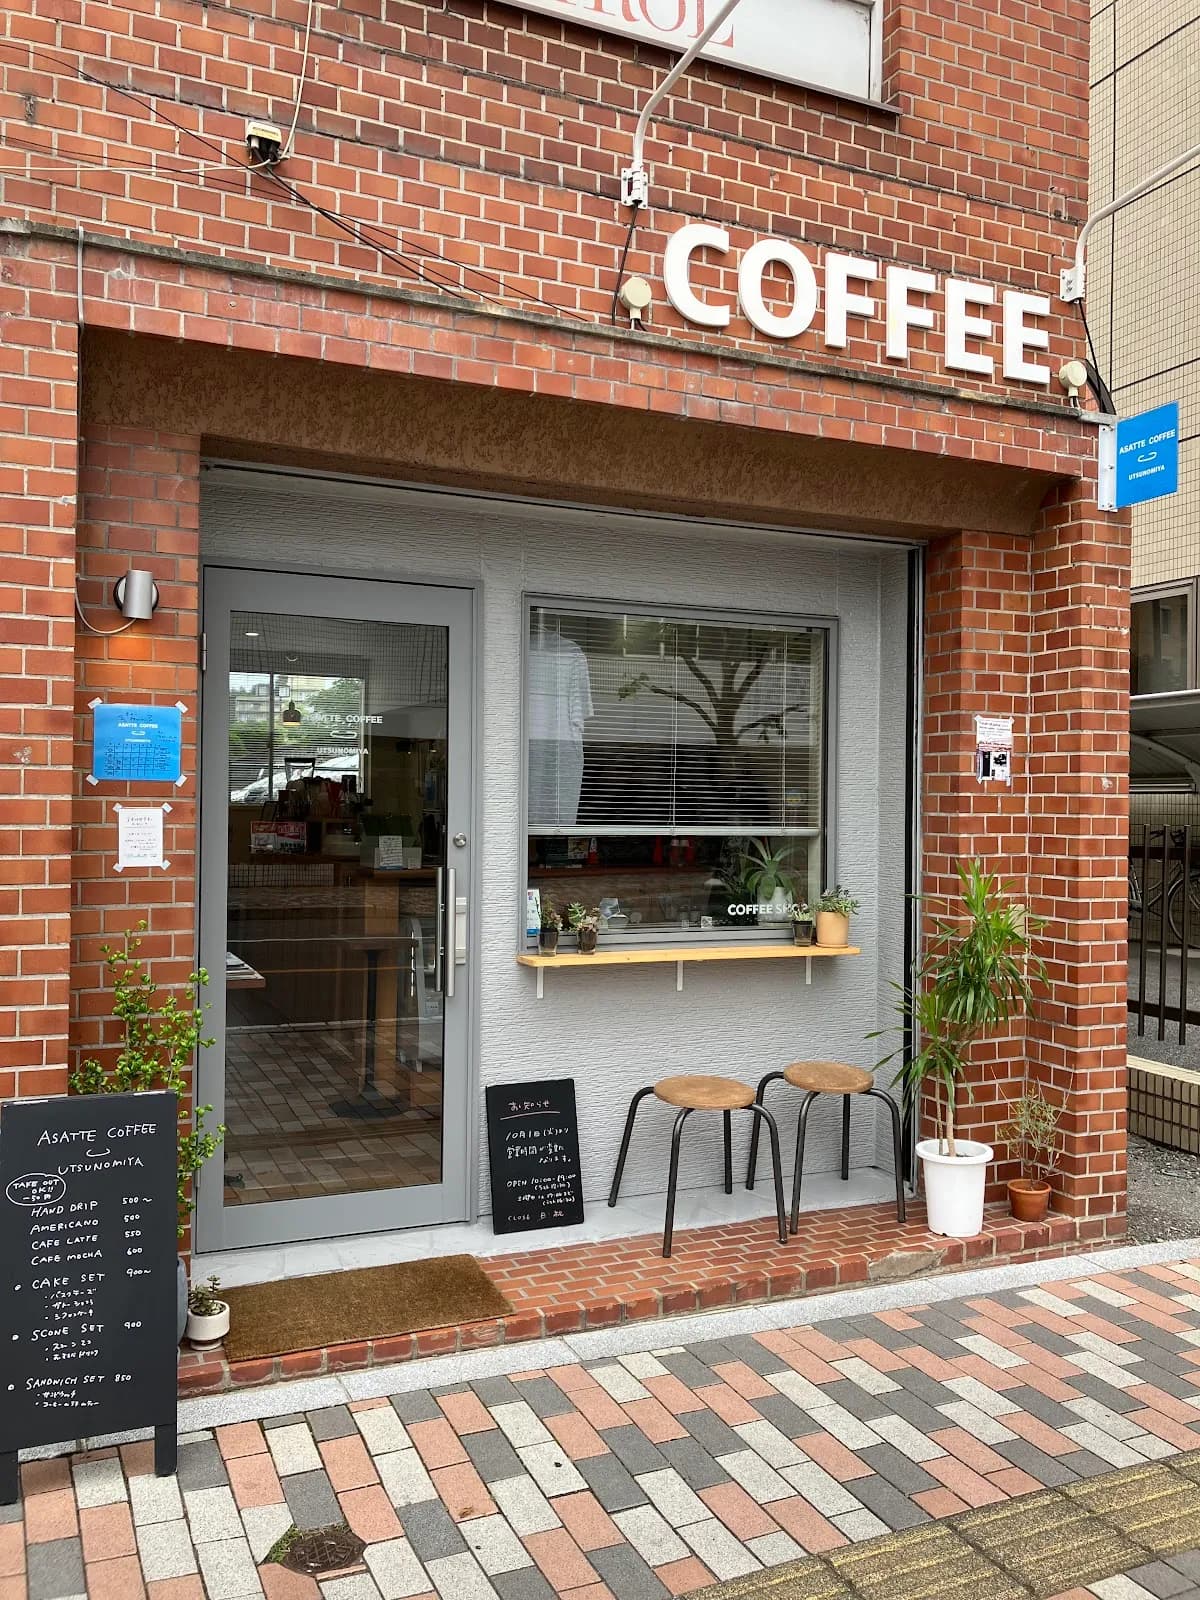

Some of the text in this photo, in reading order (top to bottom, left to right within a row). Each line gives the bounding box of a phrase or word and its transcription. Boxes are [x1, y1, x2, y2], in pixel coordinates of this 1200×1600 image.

[663, 223, 1051, 385] COFFEE
[1119, 429, 1176, 454] ASATTE COFFEE
[1128, 465, 1165, 480] UTSUNOMIYA
[345, 715, 383, 724] COFFEE
[317, 747, 369, 755] UTSUNOMIYA
[727, 903, 774, 916] COFFEE
[37, 1123, 156, 1146] ASATTE COFFEE
[58, 1157, 144, 1175] UTSUNOMIYA
[12, 1181, 38, 1190] TAKE
[506, 1180, 527, 1188] OPEN
[31, 1205, 64, 1217] HAND
[69, 1201, 99, 1213] DRIP
[29, 1214, 141, 1235] AMERICANO 500
[31, 1230, 142, 1250] CAFE LATTE 550
[31, 1247, 143, 1266] CAFE MOCHA 600
[32, 1277, 70, 1290] CAKE
[81, 1273, 105, 1283] SET
[31, 1327, 69, 1341] SCONE
[81, 1323, 104, 1333] SET
[26, 1374, 132, 1391] SANDWICH SET 850
